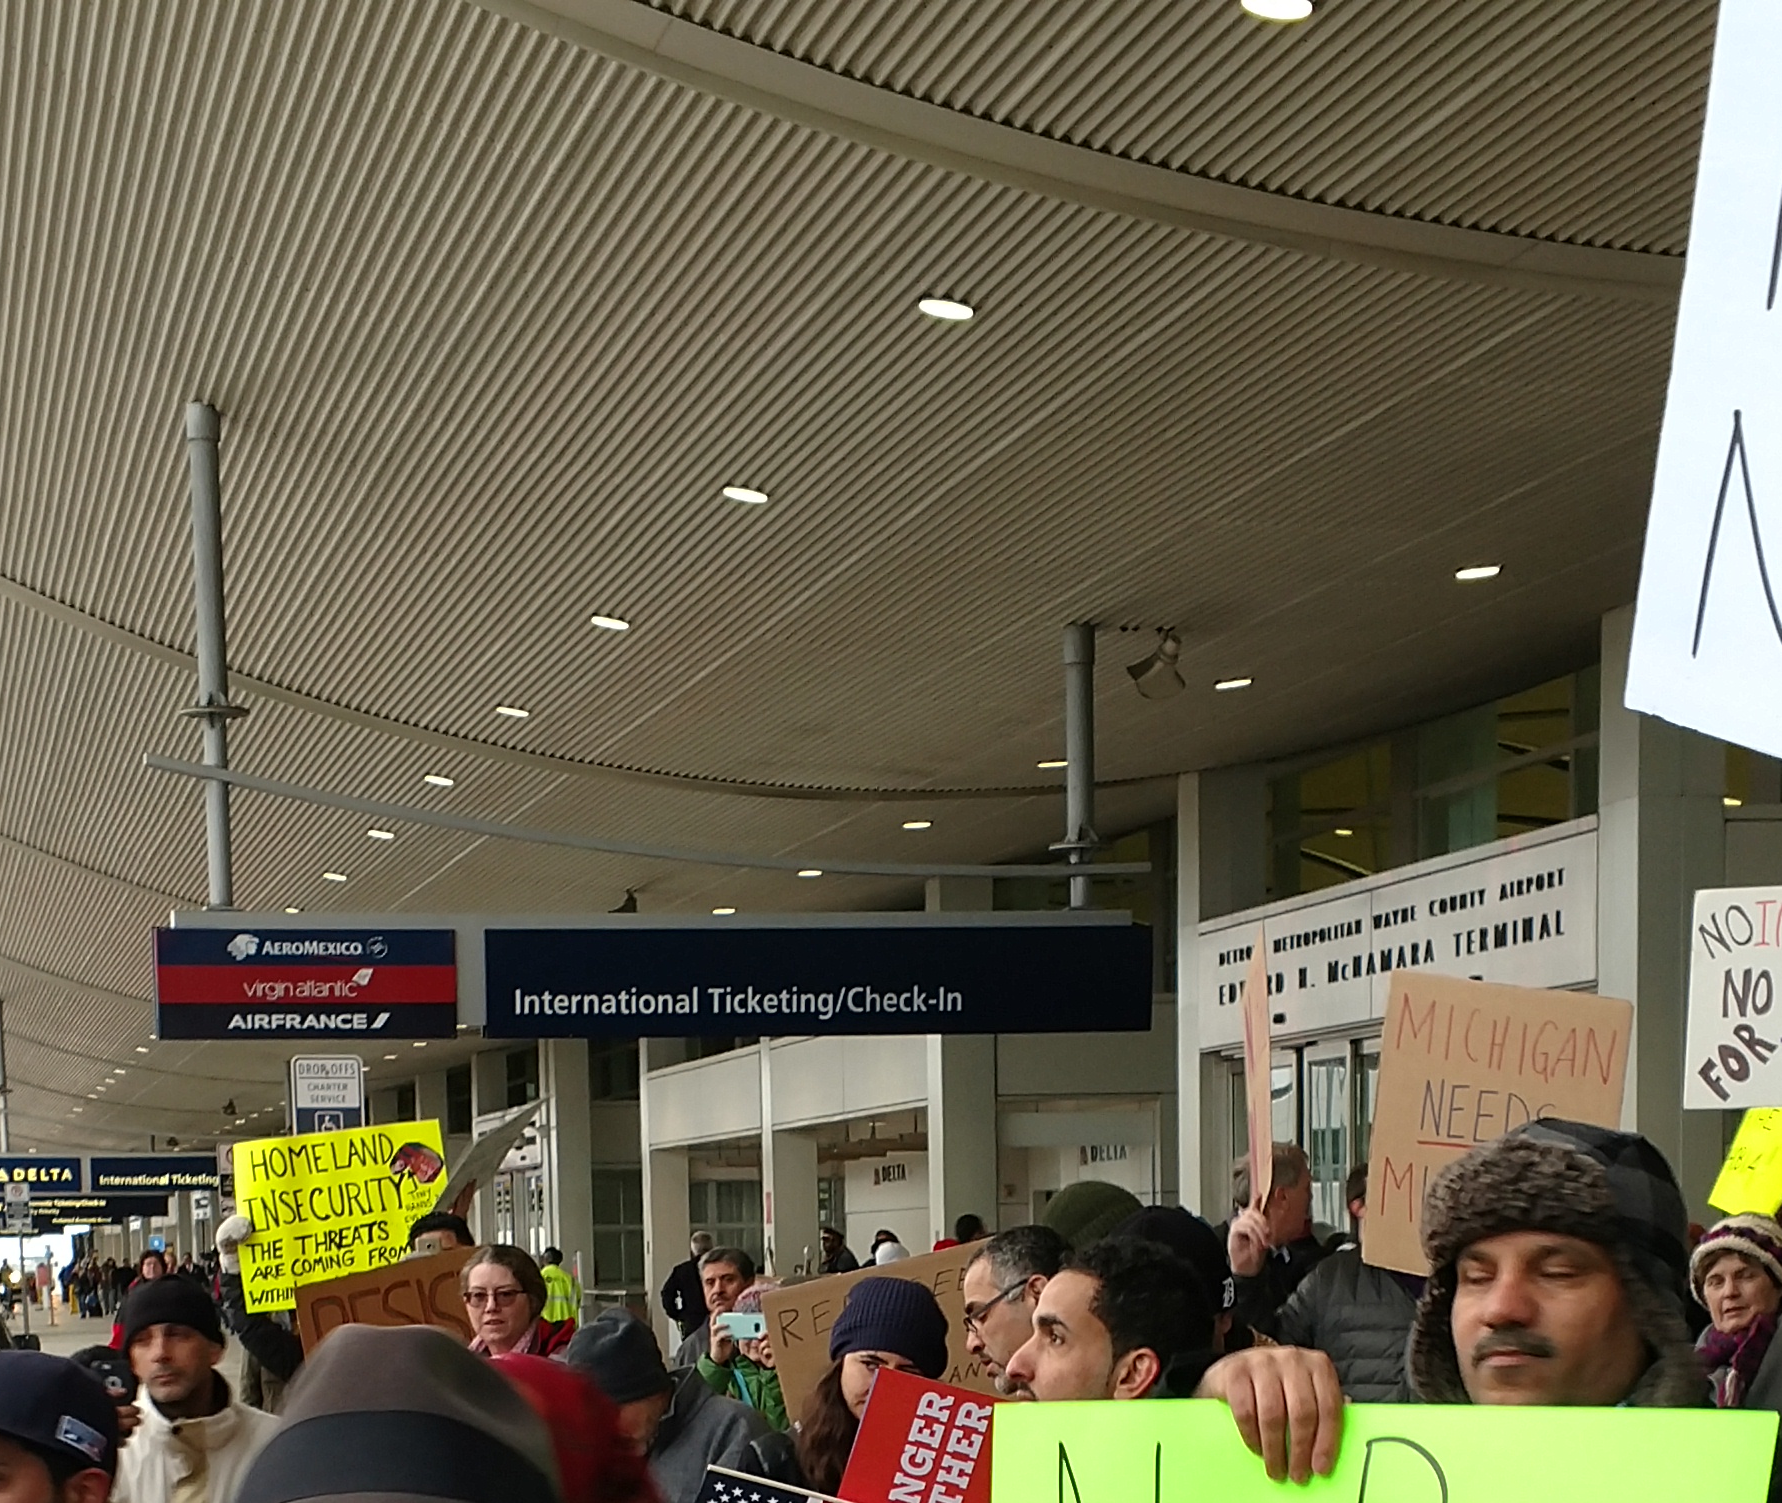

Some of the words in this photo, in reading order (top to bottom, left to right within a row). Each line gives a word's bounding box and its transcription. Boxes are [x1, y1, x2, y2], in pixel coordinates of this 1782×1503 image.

[1219, 945, 1255, 967] DETRO
[1273, 919, 1363, 954] METROPOLITAN
[1372, 905, 1418, 930] WAYNE
[1429, 889, 1486, 917] COUNTY
[1499, 867, 1565, 901] AIRPORT
[1698, 904, 1754, 960] NO
[1219, 972, 1284, 1006] EDRD
[1453, 909, 1565, 958] TERMINAL
[242, 977, 293, 1001] virgin
[295, 975, 359, 998] atlantic
[514, 987, 699, 1016] International
[707, 985, 964, 1021] Ticketing/Check-In
[1722, 967, 1773, 1019] NO
[227, 1012, 368, 1030] AIRFRANCE
[1396, 992, 1618, 1086] MICHIGAN
[1698, 1023, 1779, 1102] FOR
[13, 1167, 73, 1182] DELTA
[250, 1132, 394, 1183] HOMELAND
[881, 1163, 906, 1182] DELTA
[1090, 1145, 1127, 1162] DELTA
[99, 1174, 169, 1186] International
[171, 1174, 219, 1187] Ticketing
[243, 1172, 406, 1233] INSECURITY
[245, 1239, 284, 1264] THE
[293, 1221, 390, 1256] THREATS
[250, 1263, 286, 1283] ARE
[290, 1250, 355, 1277] COMING
